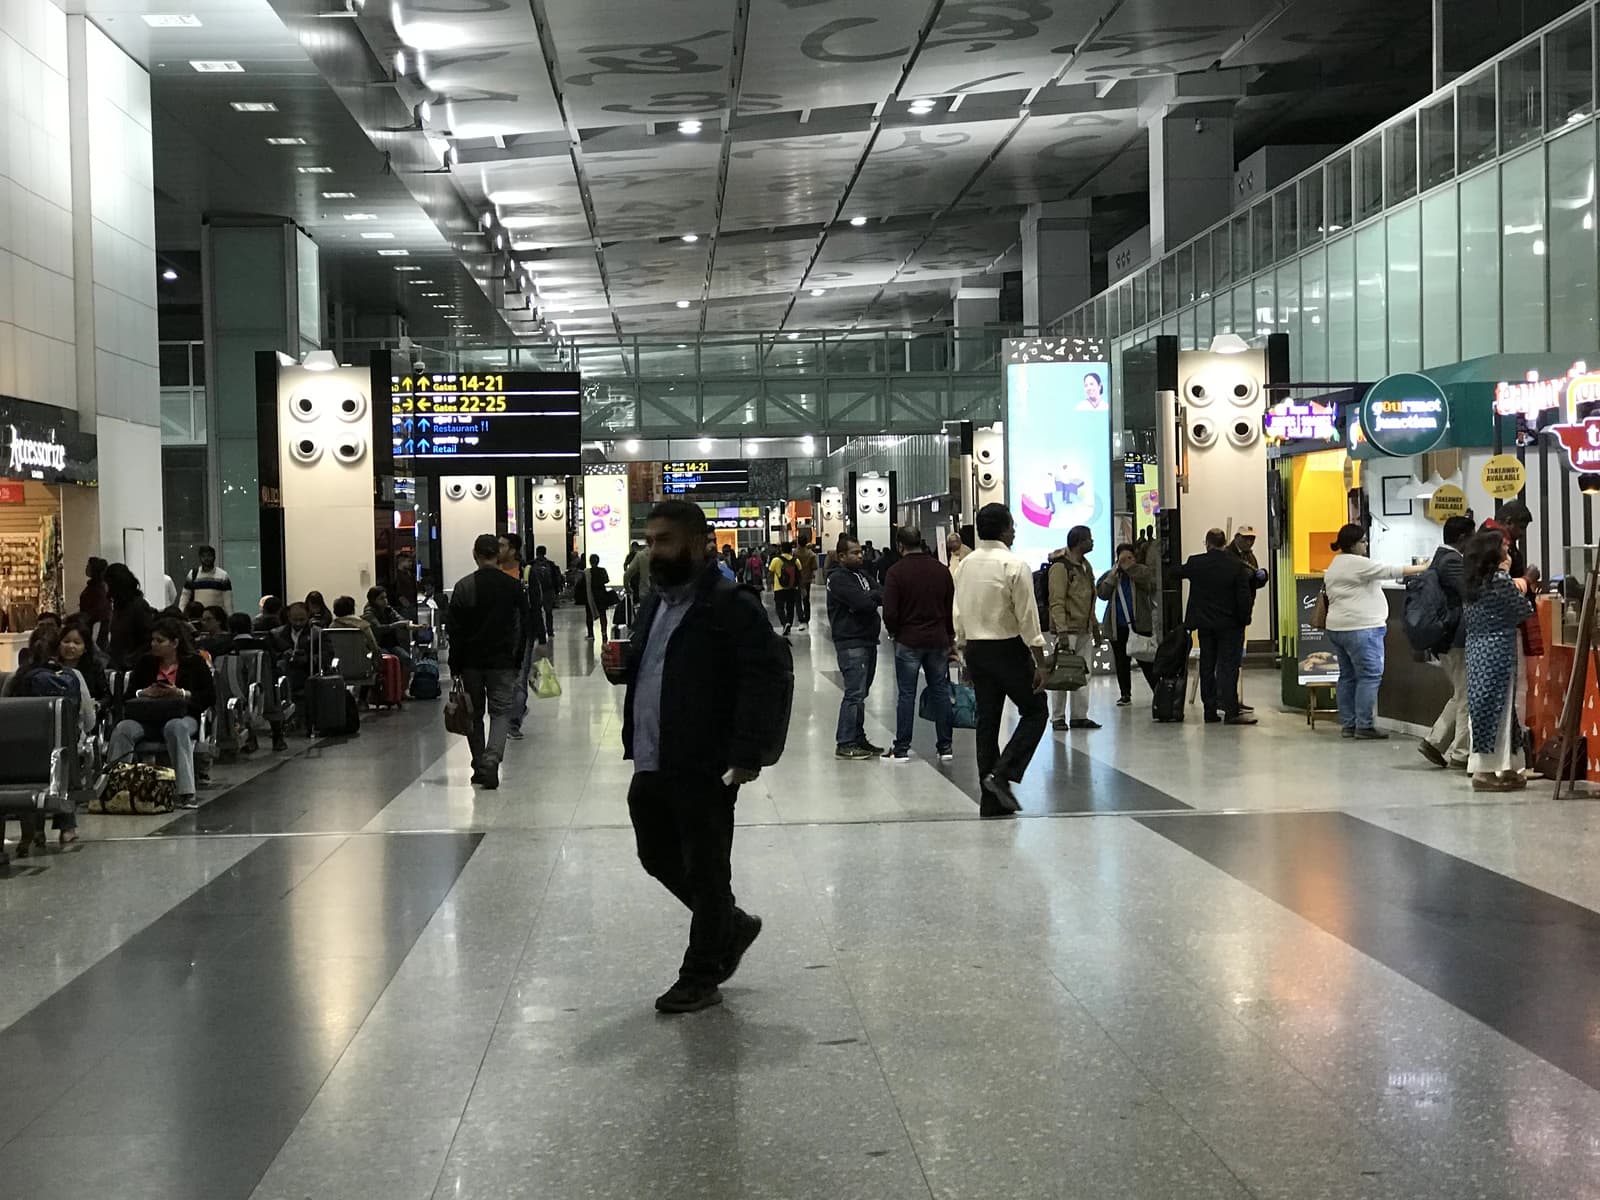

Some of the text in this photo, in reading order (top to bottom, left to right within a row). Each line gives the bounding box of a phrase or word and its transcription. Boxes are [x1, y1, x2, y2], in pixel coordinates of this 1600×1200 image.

[460, 375, 503, 391] 14-21
[460, 396, 507, 412] 22-25
[433, 424, 479, 433] Restaurant
[433, 445, 457, 453] Retail
[685, 462, 709, 471] 14-21
